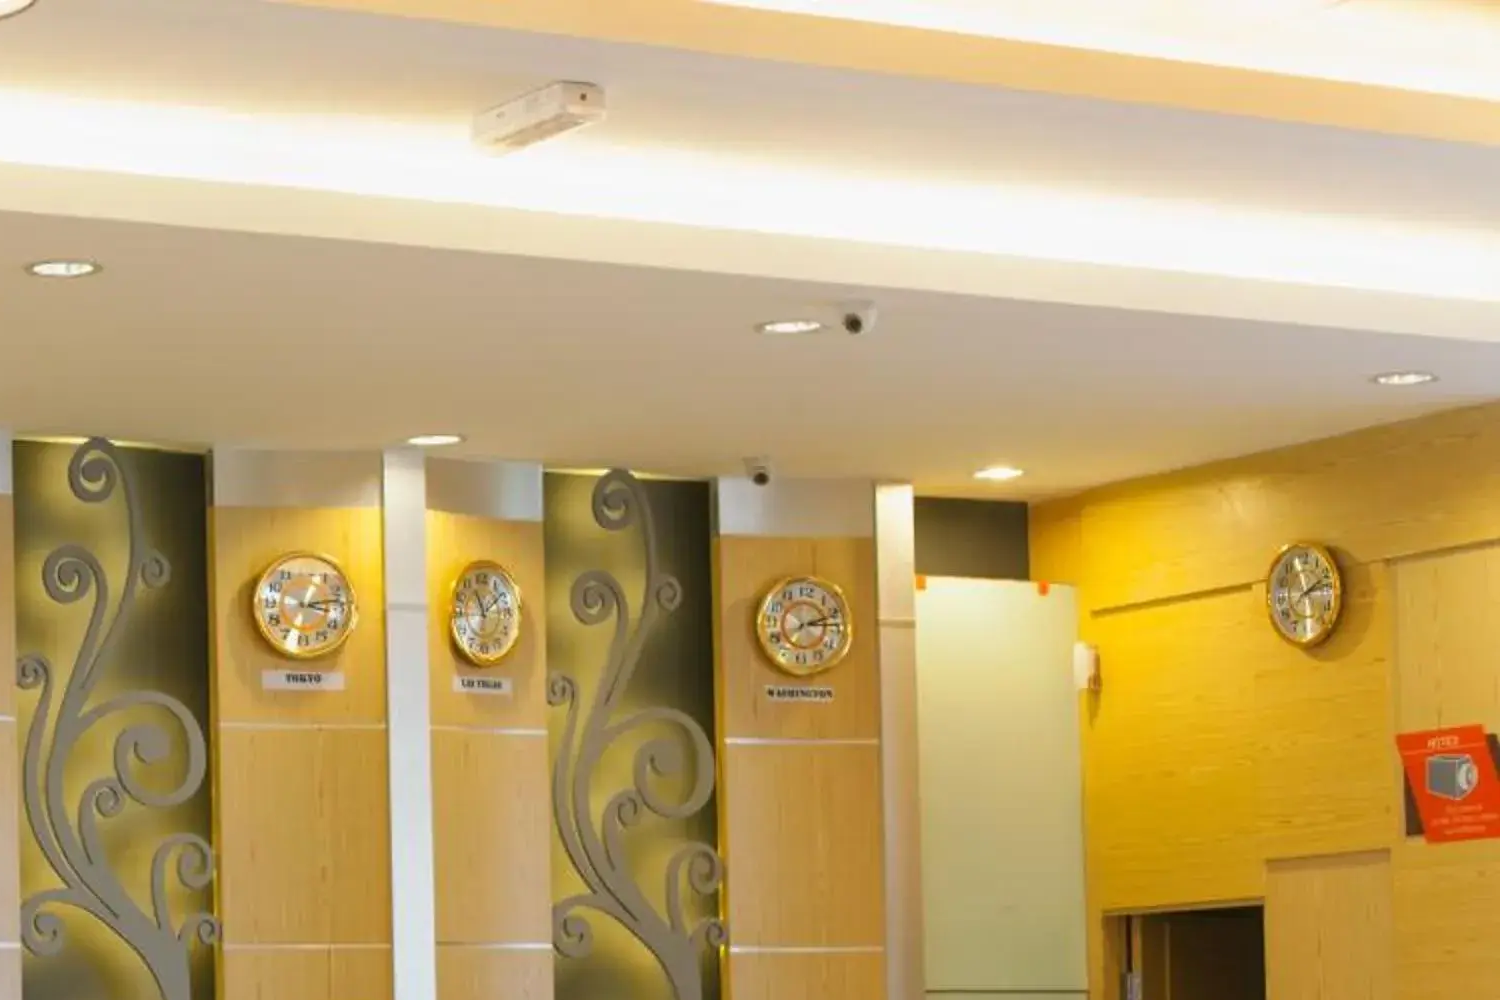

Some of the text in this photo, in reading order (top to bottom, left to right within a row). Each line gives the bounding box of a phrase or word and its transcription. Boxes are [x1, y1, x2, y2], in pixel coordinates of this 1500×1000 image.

[269, 582, 282, 592] 10
[783, 591, 793, 601] 11
[800, 588, 815, 597] 12
[285, 673, 322, 683] TOKYO
